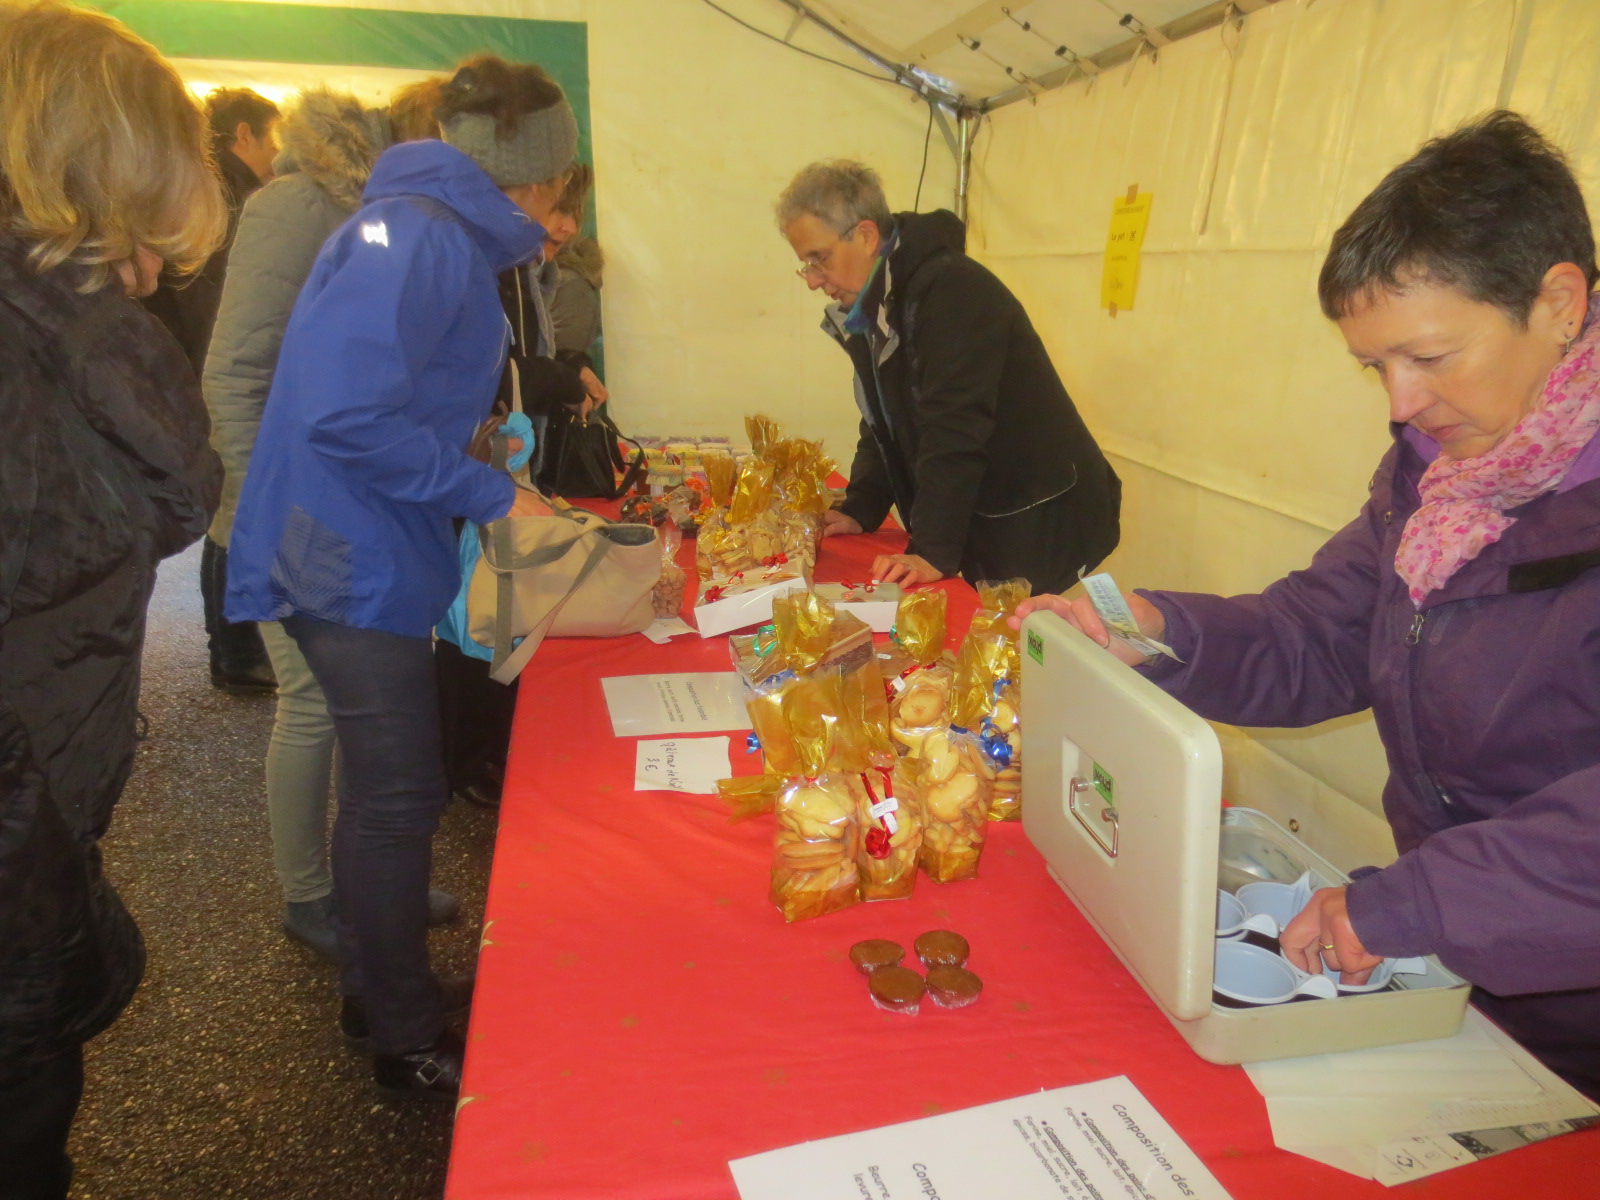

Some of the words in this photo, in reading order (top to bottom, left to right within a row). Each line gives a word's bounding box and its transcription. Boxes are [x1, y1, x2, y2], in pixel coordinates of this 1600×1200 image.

[1029, 1142, 1062, 1184] bicarbonate
[1059, 1184, 1070, 1195] de
[1042, 1126, 1078, 1167] Composition
[1076, 1168, 1089, 1182] des
[1085, 1183, 1106, 1200] pain
[1083, 1117, 1119, 1158] Composition
[1116, 1158, 1131, 1172] des
[1127, 1173, 1148, 1194] pains
[1112, 1104, 1173, 1171] Composition
[1171, 1173, 1196, 1197] des
